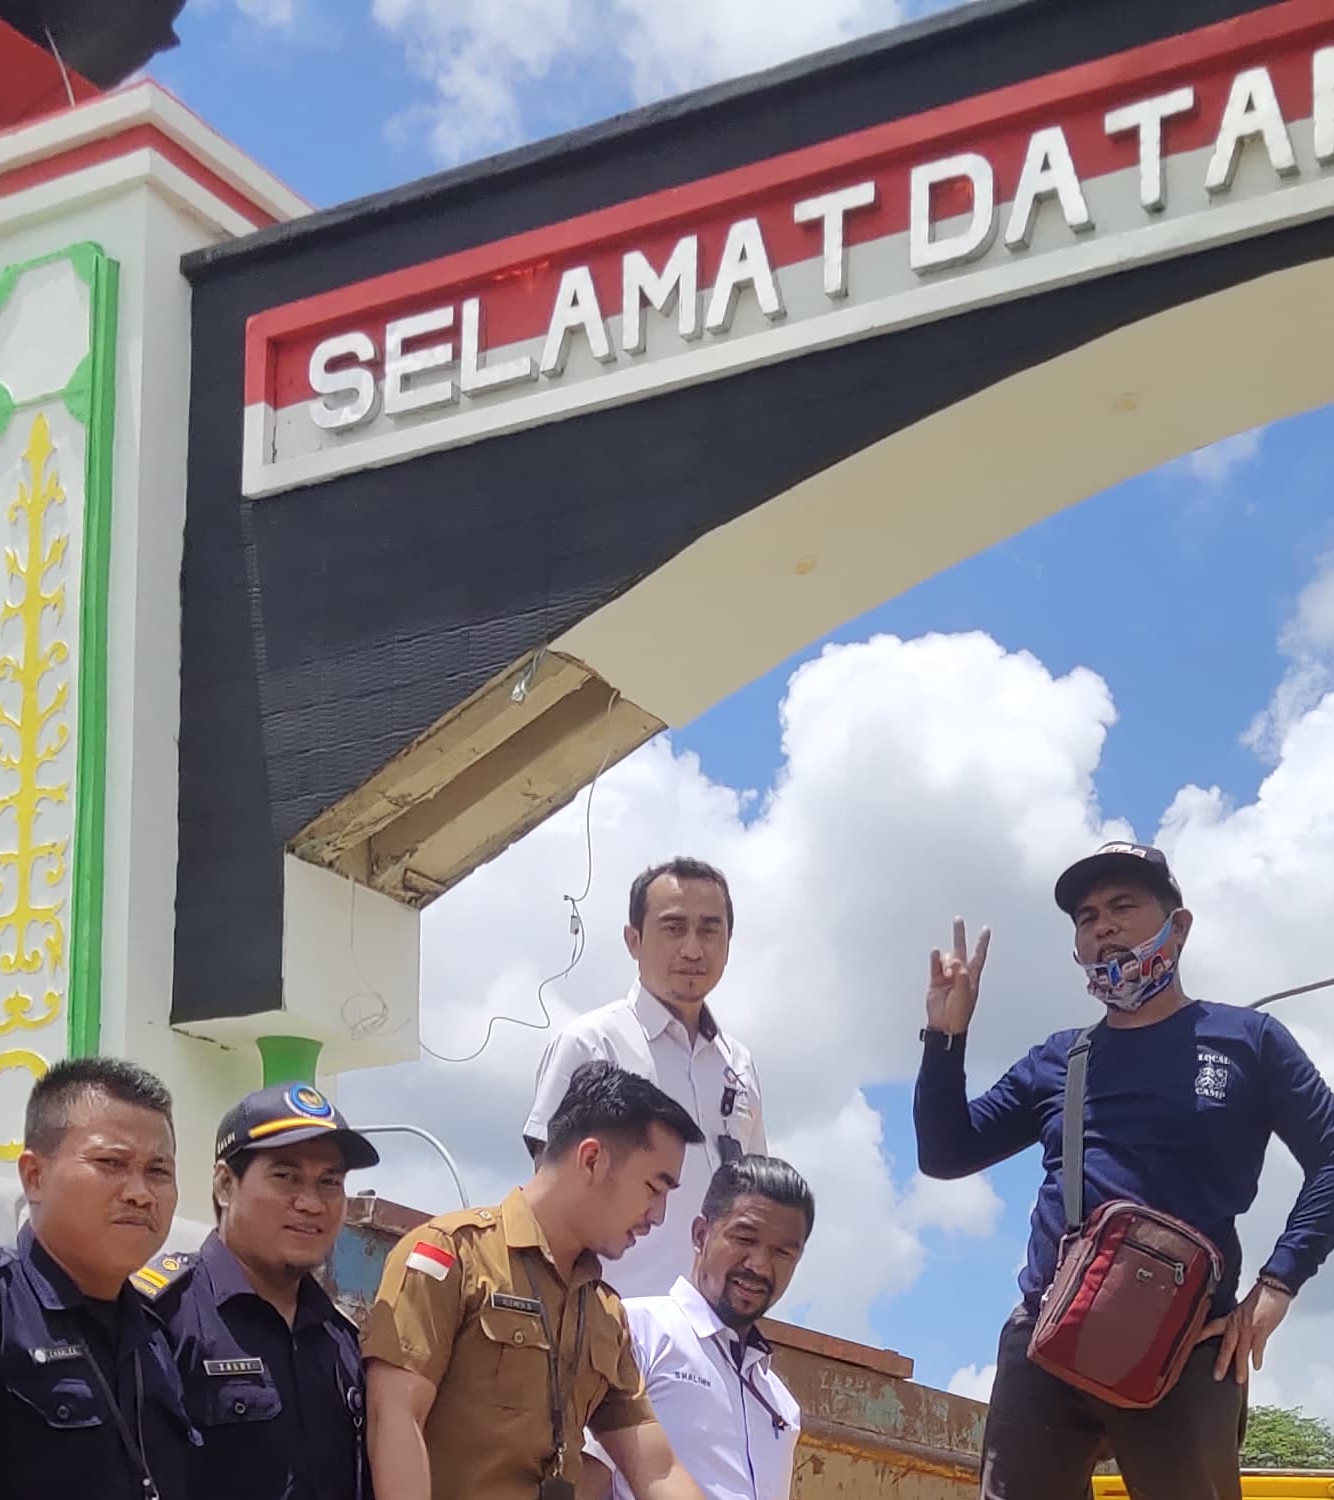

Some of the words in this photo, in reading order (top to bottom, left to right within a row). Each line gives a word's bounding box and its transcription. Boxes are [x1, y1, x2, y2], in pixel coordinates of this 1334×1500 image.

[308, 181, 875, 433] SELAMAT
[1197, 1053, 1230, 1065] LOCAL
[1195, 1087, 1226, 1099] CAMP
